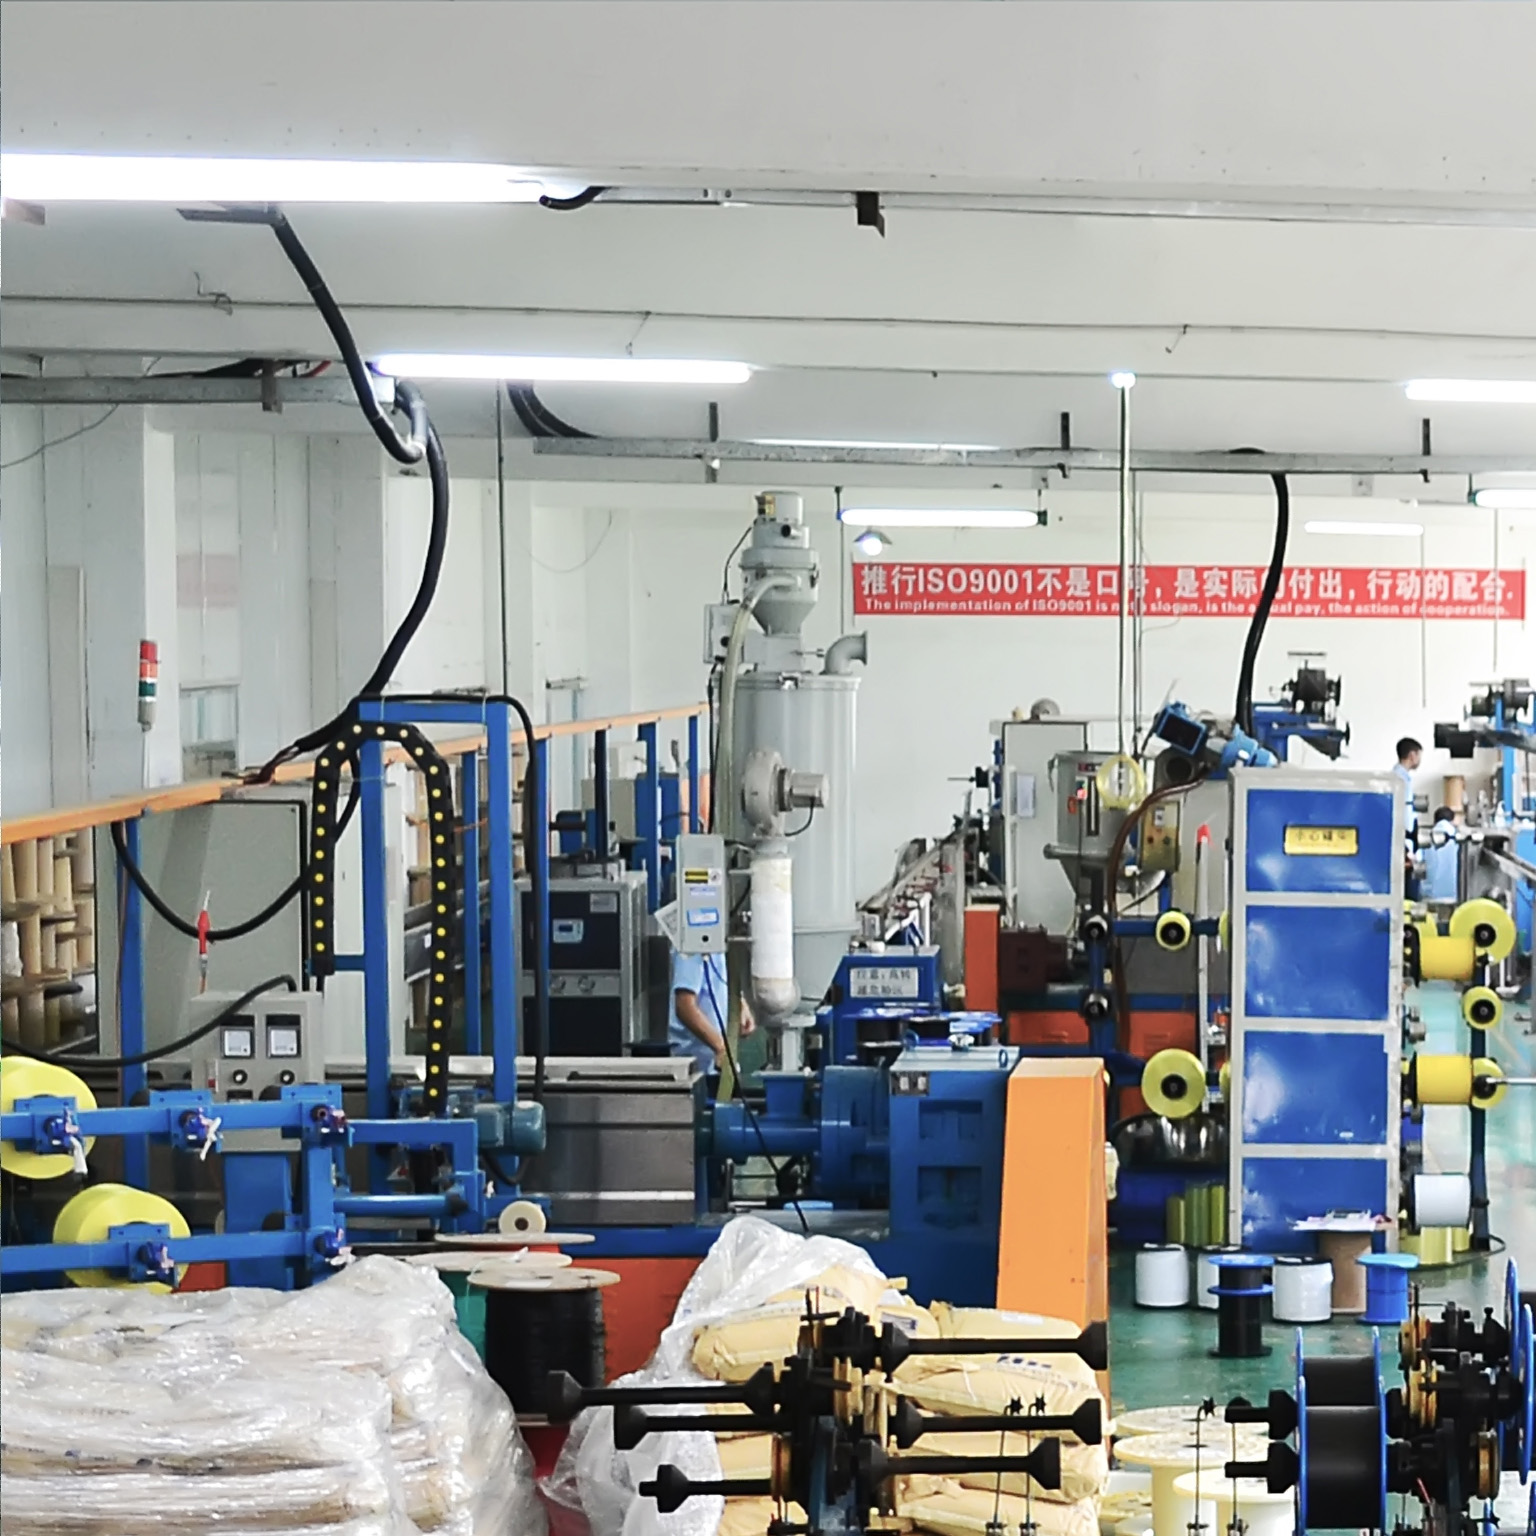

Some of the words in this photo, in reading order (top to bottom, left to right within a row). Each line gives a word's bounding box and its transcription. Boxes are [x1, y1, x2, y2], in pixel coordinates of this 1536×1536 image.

[866, 598, 891, 610] The
[895, 598, 1011, 613] implementation
[1015, 598, 1030, 611] of
[1033, 598, 1090, 612] ISO9001
[1096, 599, 1107, 612] is
[1206, 600, 1218, 613] is
[1221, 601, 1245, 613] the
[1248, 601, 1292, 614] aual
[1328, 602, 1352, 614] the
[1402, 602, 1417, 615] of
